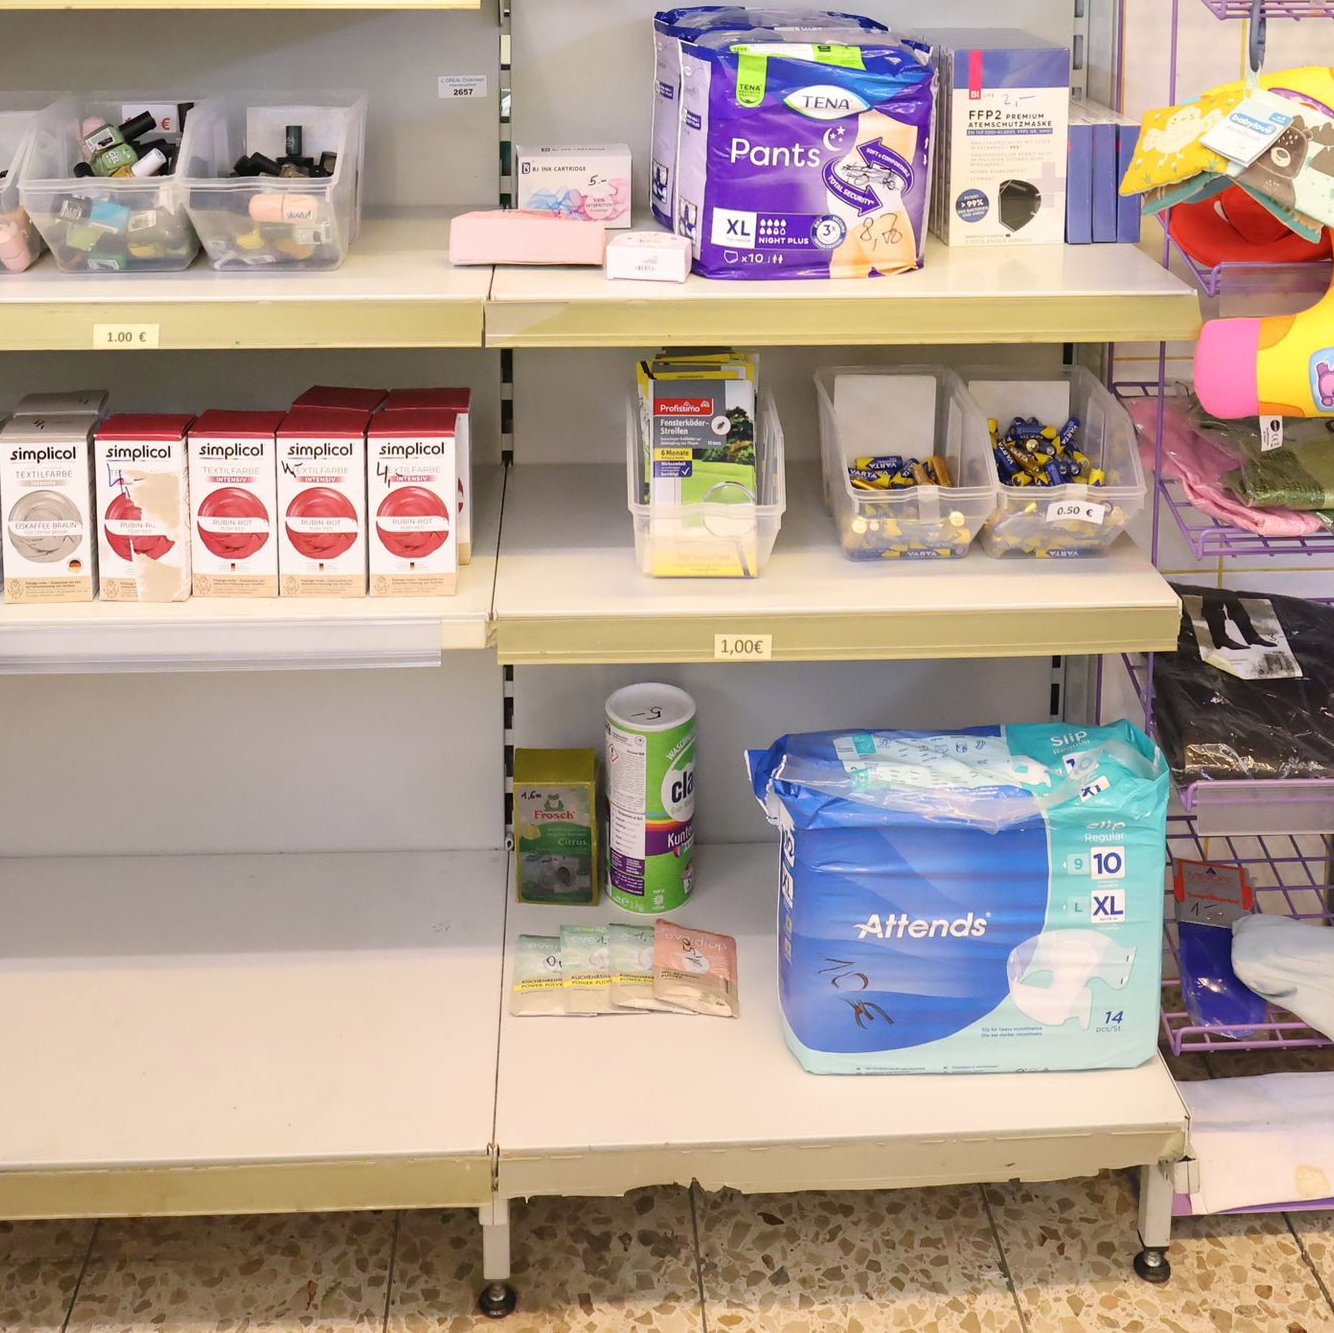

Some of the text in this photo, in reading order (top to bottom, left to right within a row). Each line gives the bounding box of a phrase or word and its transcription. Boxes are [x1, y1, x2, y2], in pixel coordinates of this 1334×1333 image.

[453, 88, 473, 96] 2657
[802, 95, 849, 109] TENA
[969, 110, 1002, 121] FFP2
[731, 137, 820, 167] Pants
[827, 176, 842, 194] TOTAL
[727, 219, 750, 237] XL
[759, 237, 785, 245] NIGHT
[741, 253, 764, 264] x10
[107, 331, 146, 342] 1.00 €
[660, 404, 700, 412] Profissimo
[10, 446, 76, 464] simplicol
[16, 470, 72, 478] TEXTILFARBE
[203, 467, 260, 475] TEXTILFARBE
[850, 469, 877, 479] VARTA
[1057, 506, 1080, 515] 0.50
[15, 521, 77, 529] EISKAFFEE-BRAUN
[721, 639, 763, 655] 1,00€
[1050, 730, 1088, 748] Slip
[534, 810, 573, 819] Frosch
[1084, 831, 1125, 843] Regular
[1074, 852, 1122, 874] 9 10
[1075, 896, 1123, 916] L XL
[853, 912, 987, 939] Attends
[1104, 1011, 1123, 1024] 14
